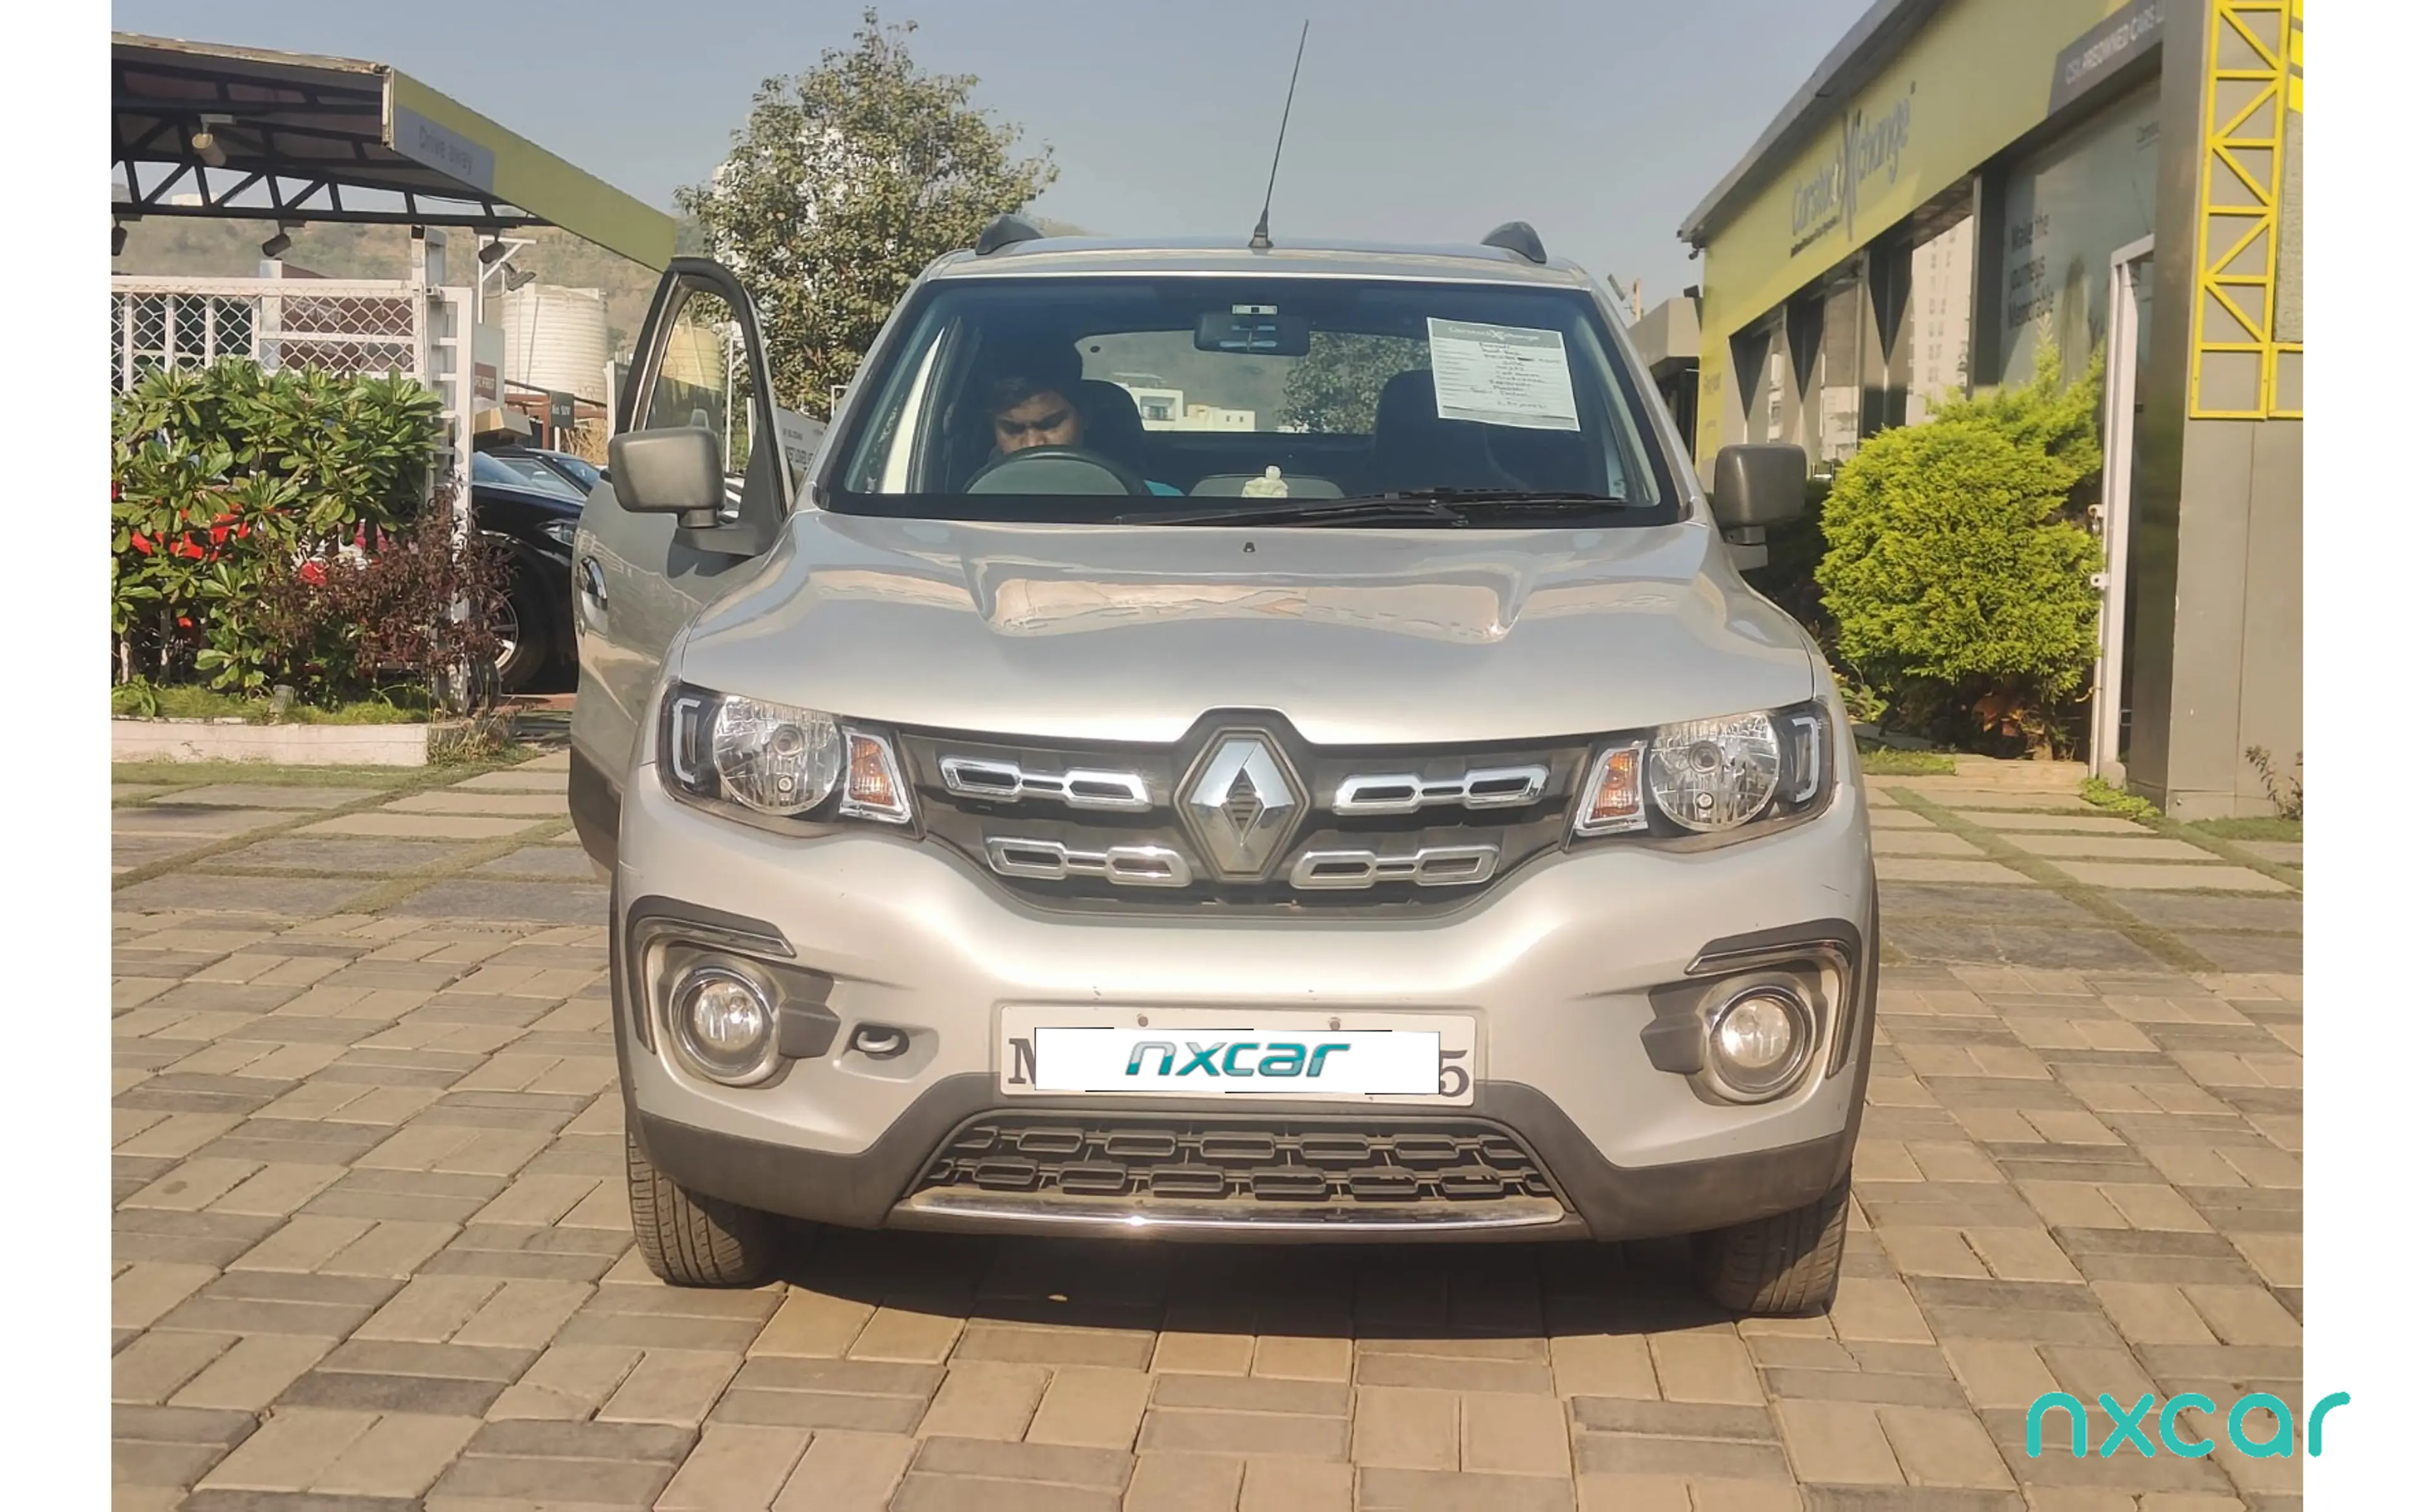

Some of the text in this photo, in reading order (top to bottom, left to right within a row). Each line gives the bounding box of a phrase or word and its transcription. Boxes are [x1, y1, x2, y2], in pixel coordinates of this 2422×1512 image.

[2082, 23, 2129, 70] PREOWNED
[419, 125, 473, 176] Drive away
[2011, 221, 2033, 252] Make
